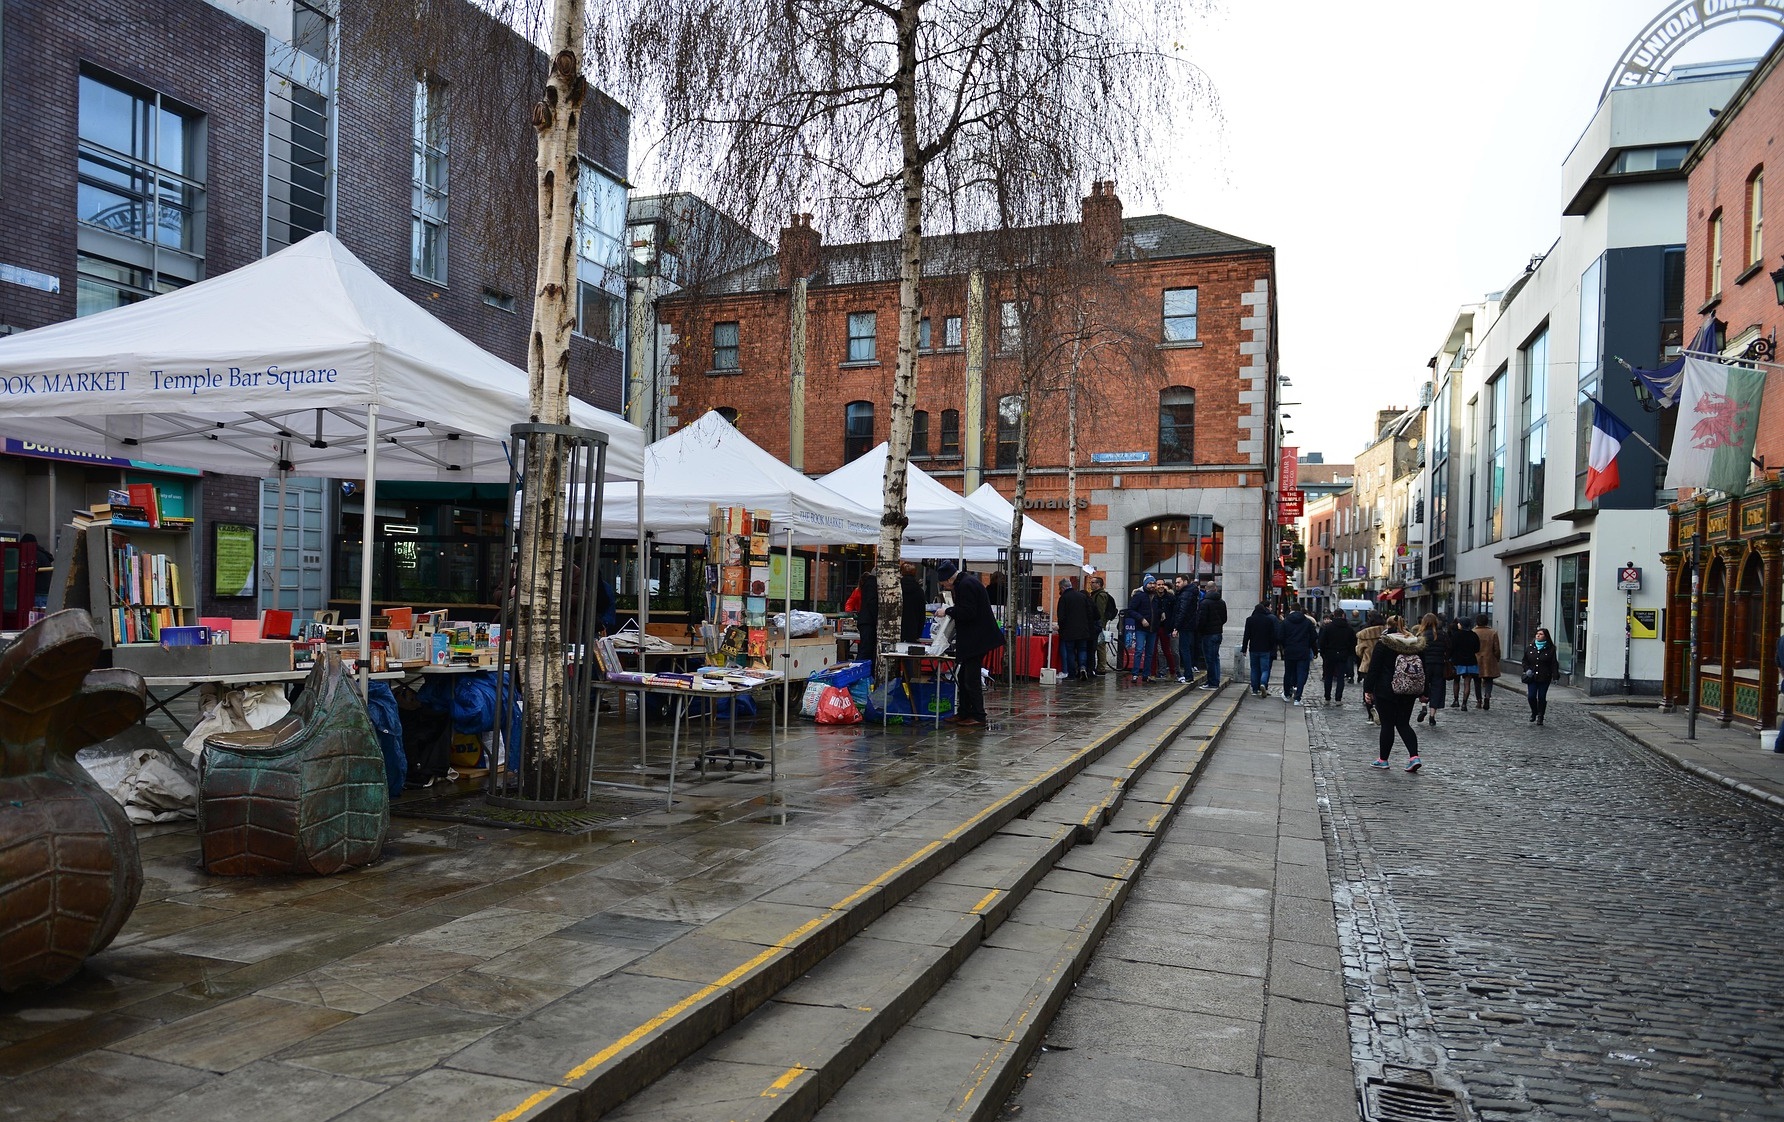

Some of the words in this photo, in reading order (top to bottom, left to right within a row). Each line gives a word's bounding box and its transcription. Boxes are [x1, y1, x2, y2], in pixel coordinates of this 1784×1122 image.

[1632, 5, 1698, 68] UNION
[42, 371, 129, 393] MARKET
[149, 368, 223, 395] Temple
[228, 367, 262, 387] Bar
[266, 365, 338, 392] Square
[810, 512, 825, 526] BOOK
[825, 515, 844, 529] MARKET
